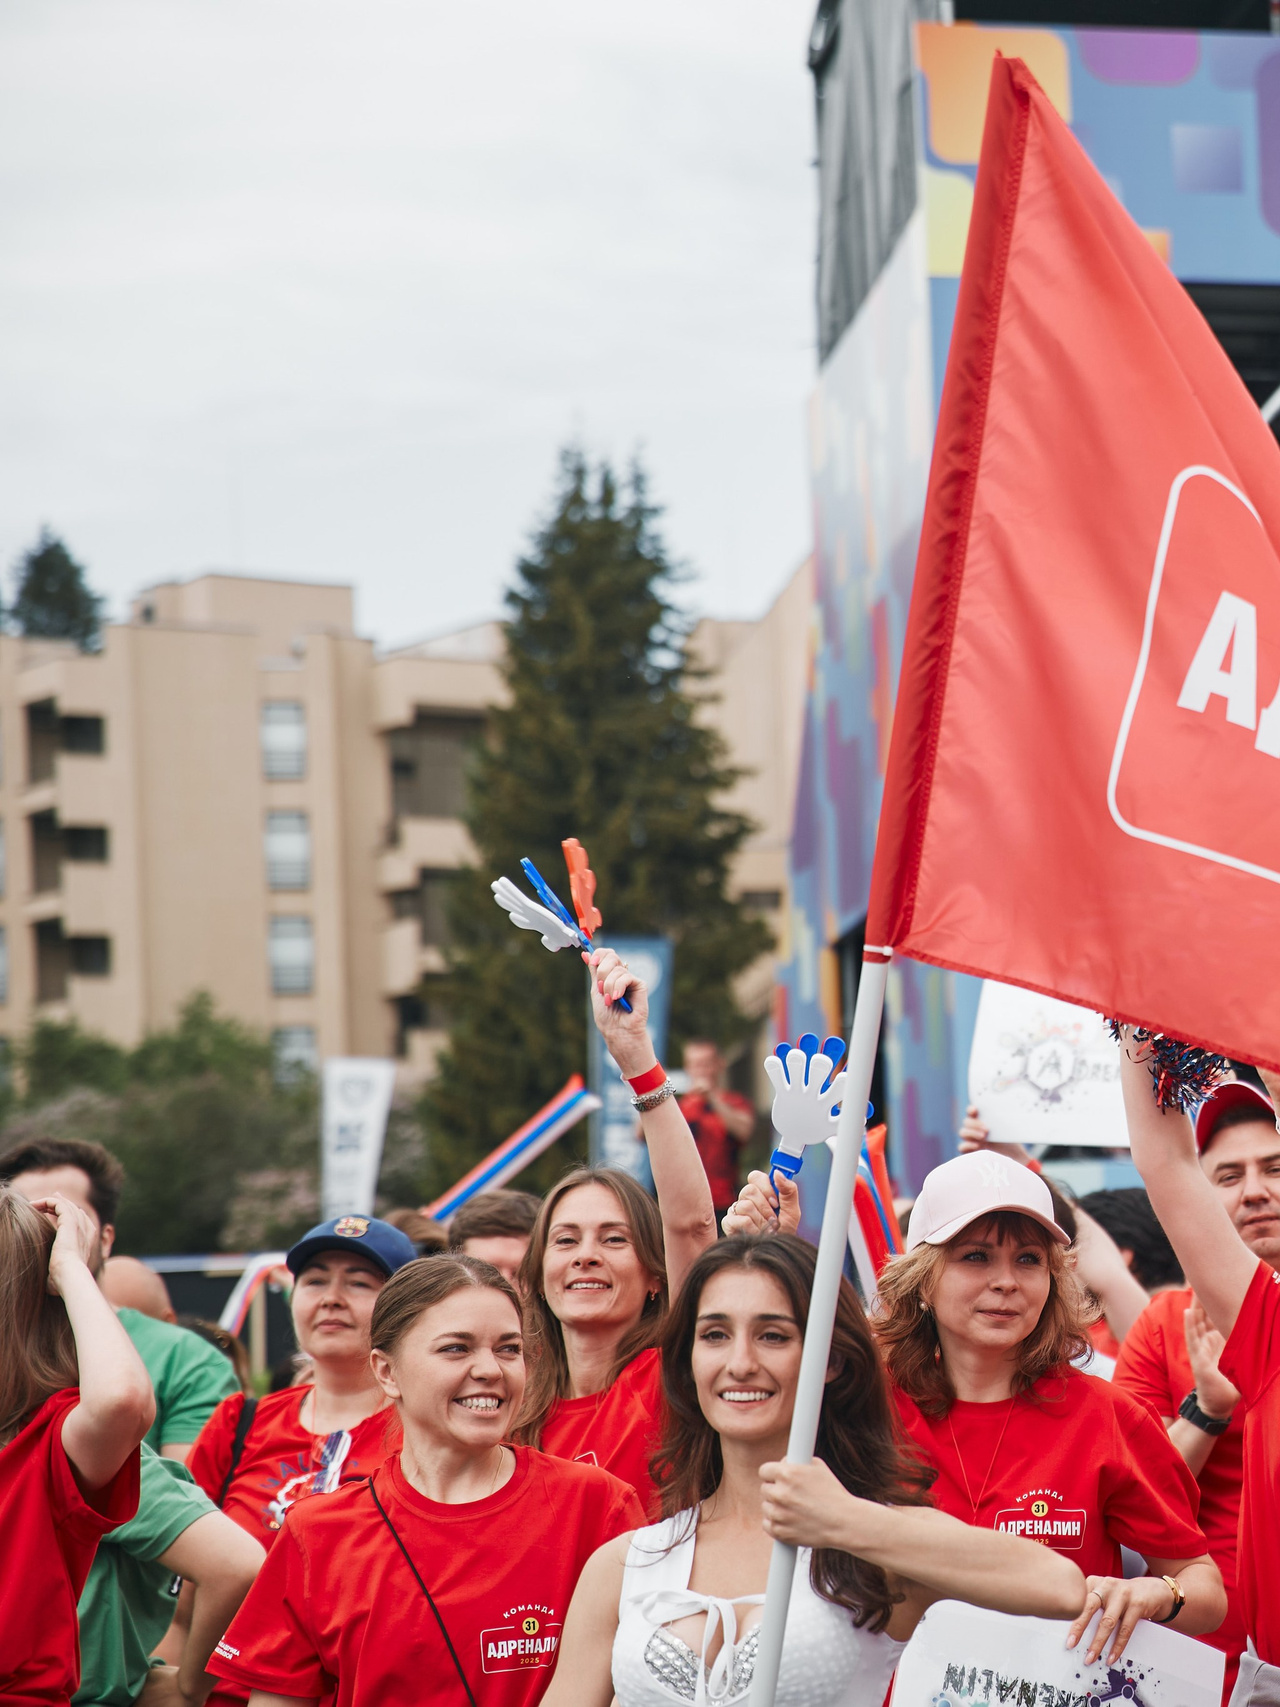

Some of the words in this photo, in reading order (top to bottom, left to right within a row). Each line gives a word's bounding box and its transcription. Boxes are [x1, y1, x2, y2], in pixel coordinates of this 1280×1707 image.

[1015, 1489, 1064, 1503] КОМАНДА
[1034, 1503, 1045, 1513] 31
[998, 1520, 1081, 1536] АДРЕНАЛИН
[503, 1604, 555, 1619] КОМАНДА
[525, 1620, 536, 1631] 31
[487, 1637, 559, 1659] АДРЕНАЛИ
